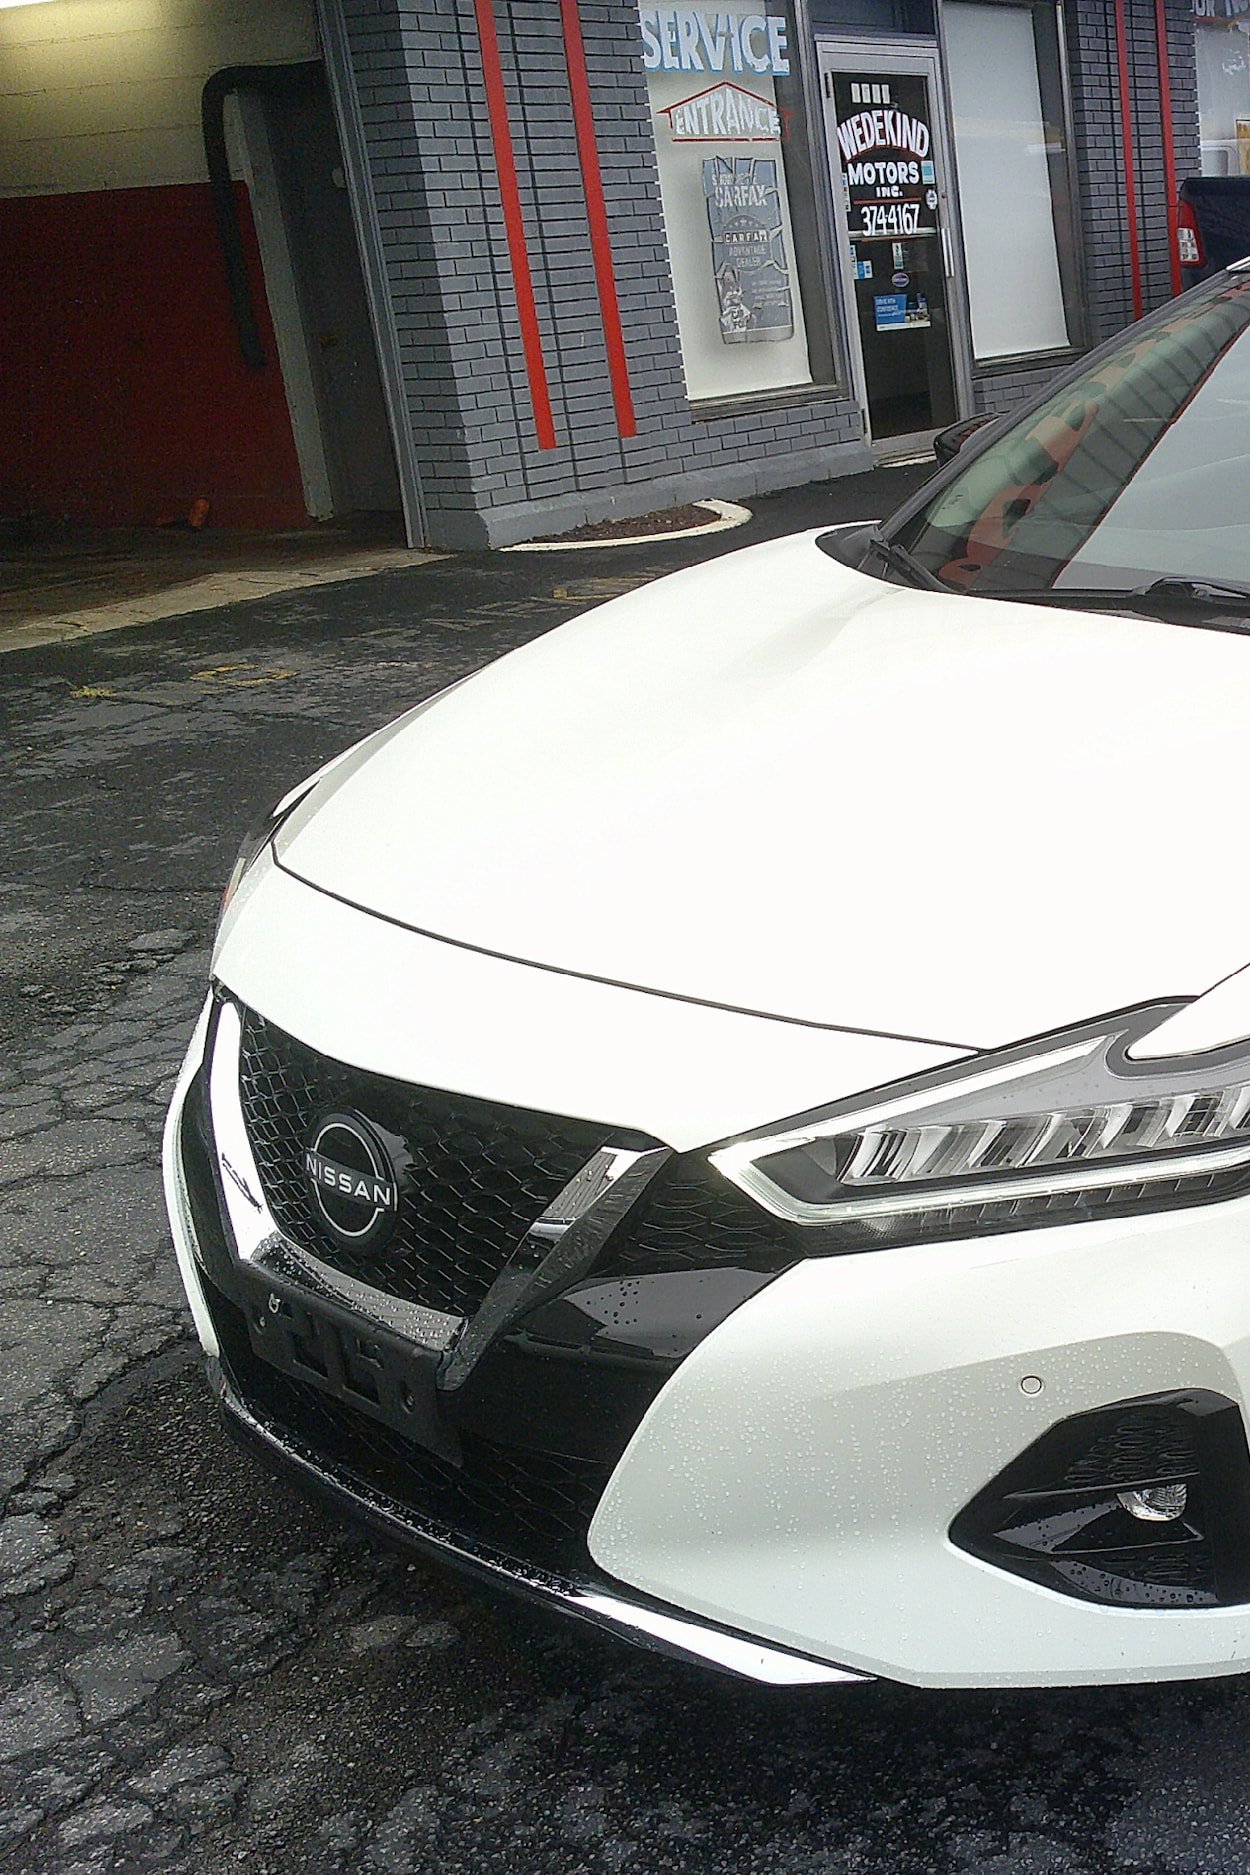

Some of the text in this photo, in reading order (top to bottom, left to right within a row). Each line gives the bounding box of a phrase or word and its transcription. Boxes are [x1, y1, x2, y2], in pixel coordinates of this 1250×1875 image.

[640, 10, 790, 76] SERVICE
[675, 87, 781, 136] ENTRANCE
[836, 109, 930, 161] WEDEKIND
[847, 161, 921, 185] MOTORS
[714, 184, 768, 208] CARFAX
[876, 186, 904, 198] INC.
[860, 203, 921, 236] 374-4167
[724, 230, 768, 244] CARFAX
[305, 1153, 391, 1206] NISSAN
